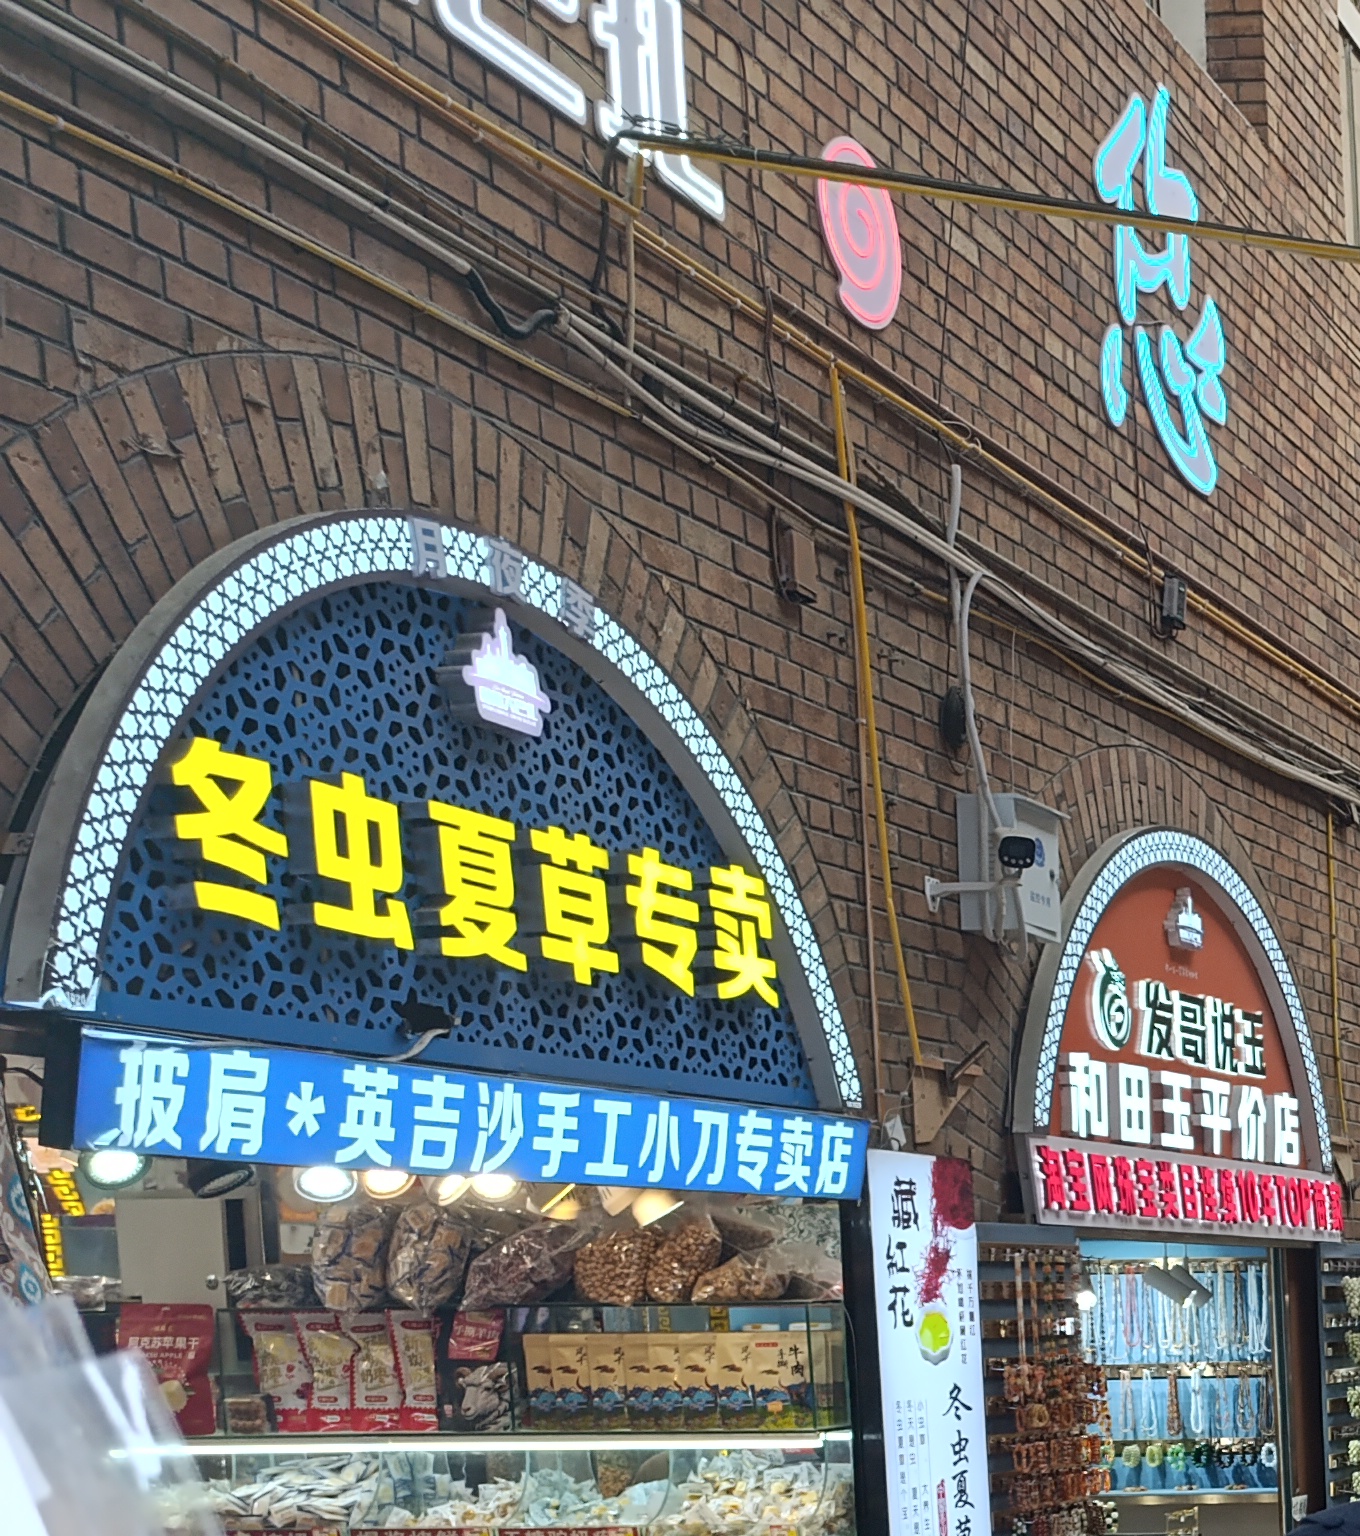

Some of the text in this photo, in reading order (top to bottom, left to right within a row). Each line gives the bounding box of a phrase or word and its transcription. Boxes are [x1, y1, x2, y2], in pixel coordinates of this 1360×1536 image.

[171, 737, 782, 1009] 冬虫夏草专卖
[337, 1066, 857, 1197] 英吉沙手工小刀专卖店
[1068, 1052, 1301, 1166] 和田玉平价店
